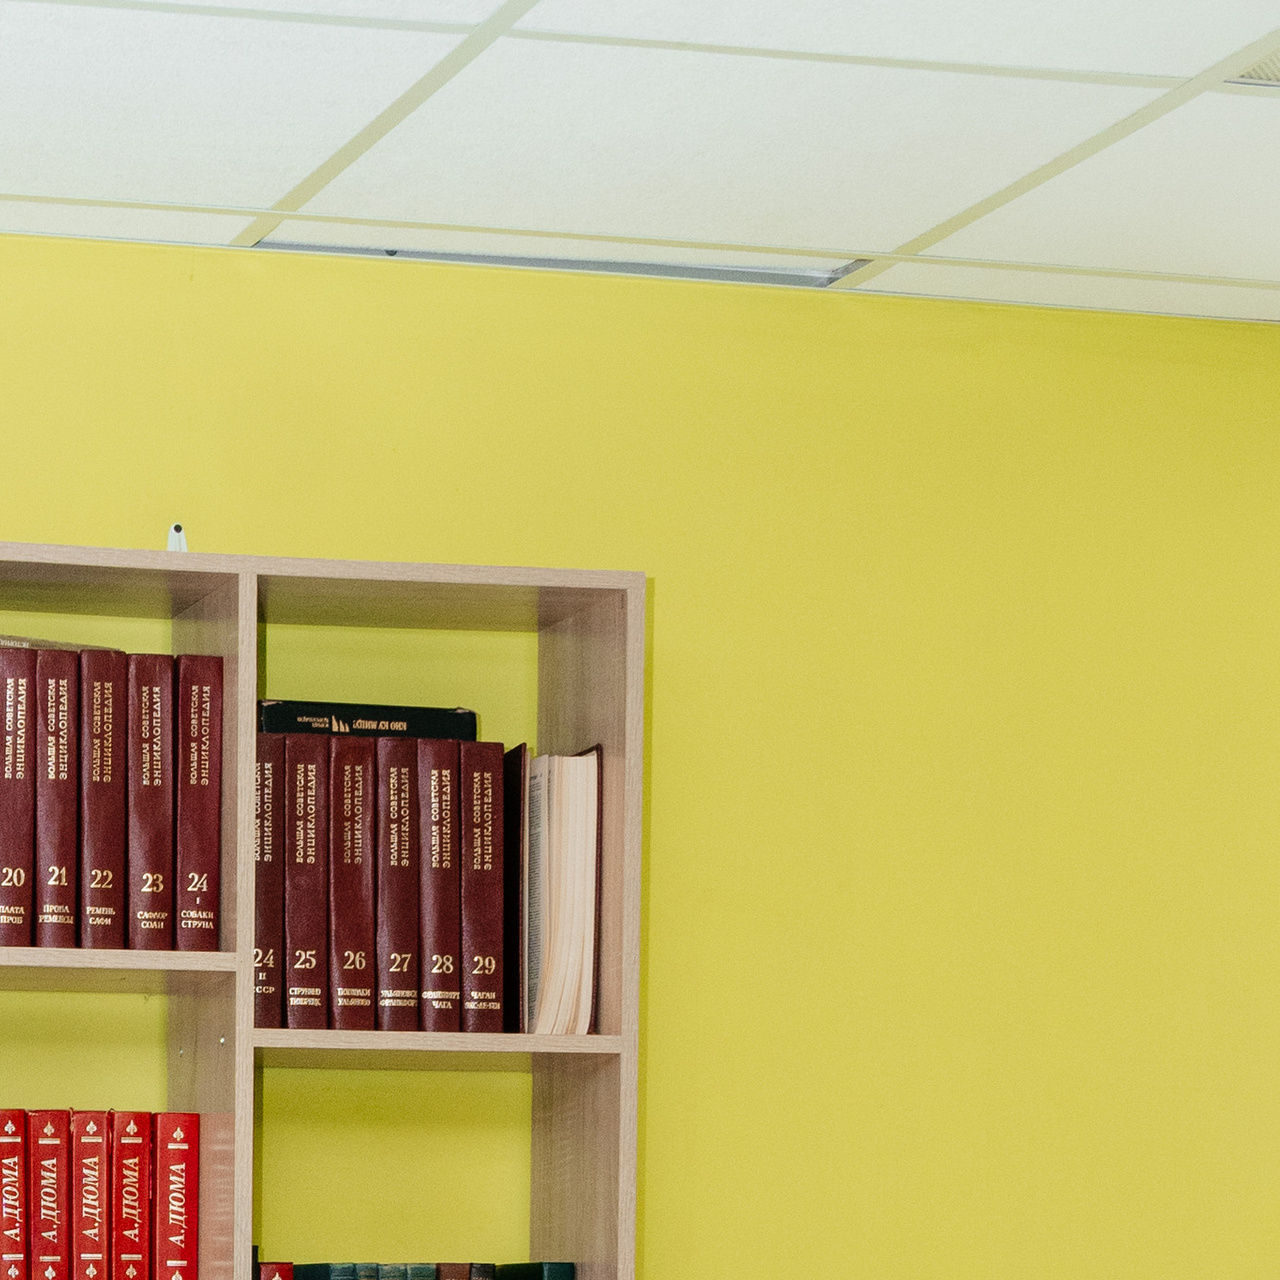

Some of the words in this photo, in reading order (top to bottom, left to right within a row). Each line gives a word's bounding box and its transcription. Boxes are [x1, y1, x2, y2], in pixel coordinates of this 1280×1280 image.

[307, 765, 316, 863] ЭНЦИКЛОПЕДИЯ
[296, 821, 304, 863] БОЛЬШАЯ
[1, 867, 25, 886] 20
[47, 865, 67, 886] 21
[88, 866, 112, 893] 22
[141, 873, 163, 892] 23
[187, 873, 207, 891] 24
[254, 949, 274, 968] 24
[294, 950, 316, 968] 25
[343, 951, 365, 969] 26
[389, 953, 411, 972] 27
[431, 955, 453, 973] 28
[472, 956, 495, 974] 29
[3, 1156, 20, 1241] А.ДЮМА
[41, 1158, 58, 1243] А.ДЮМА
[82, 1156, 99, 1242] А.ДЮМА
[122, 1156, 139, 1242] А.ДЮМА
[168, 1162, 186, 1248] А.ДЮМА
